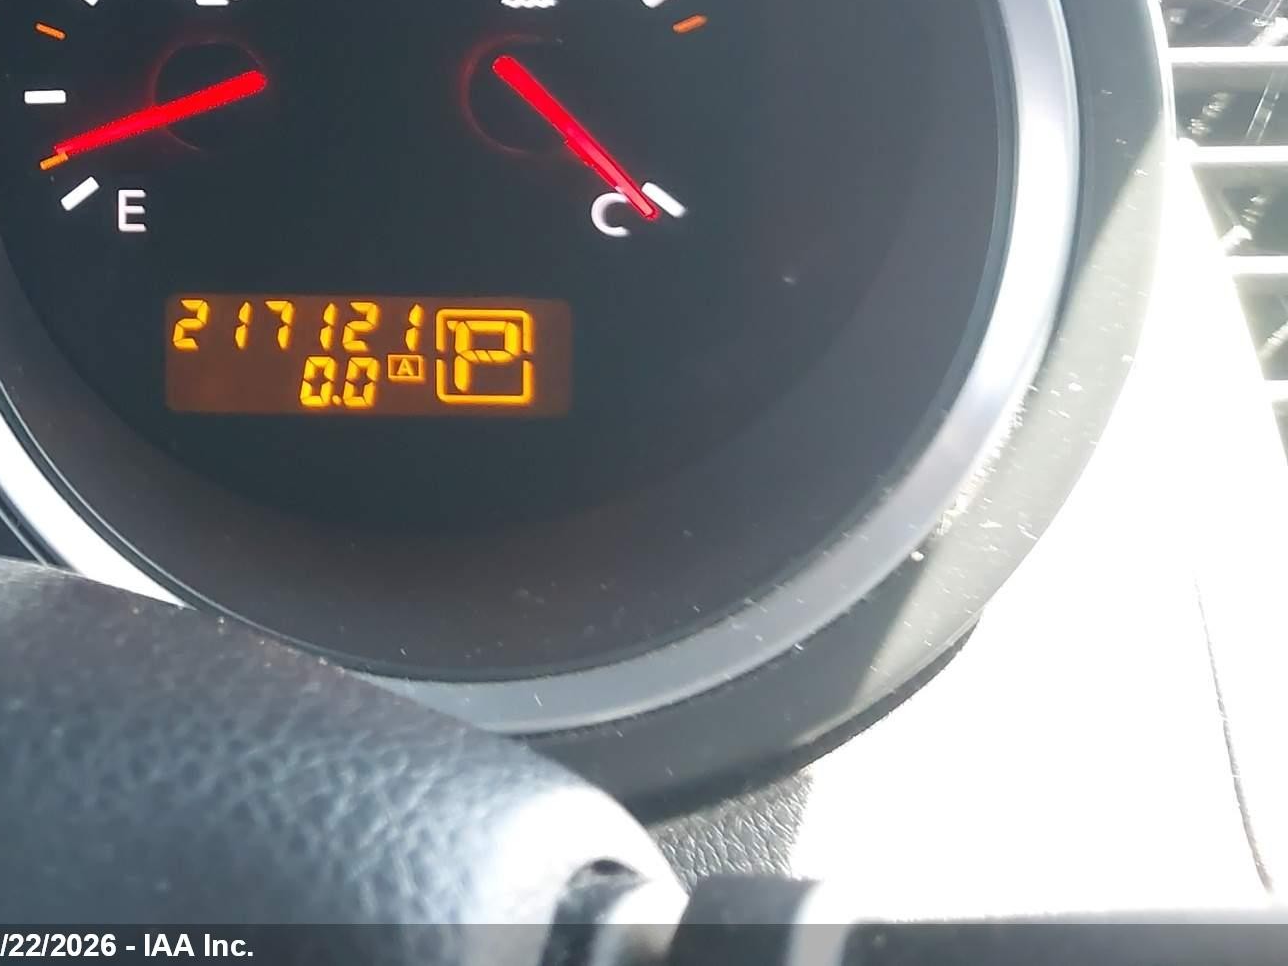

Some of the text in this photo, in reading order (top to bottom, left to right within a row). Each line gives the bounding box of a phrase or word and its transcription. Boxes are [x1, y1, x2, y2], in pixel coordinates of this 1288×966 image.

[118, 190, 146, 232] E
[591, 192, 631, 236] C
[173, 300, 423, 351] 217121
[300, 356, 379, 407] 0.0
[448, 320, 518, 393] P
